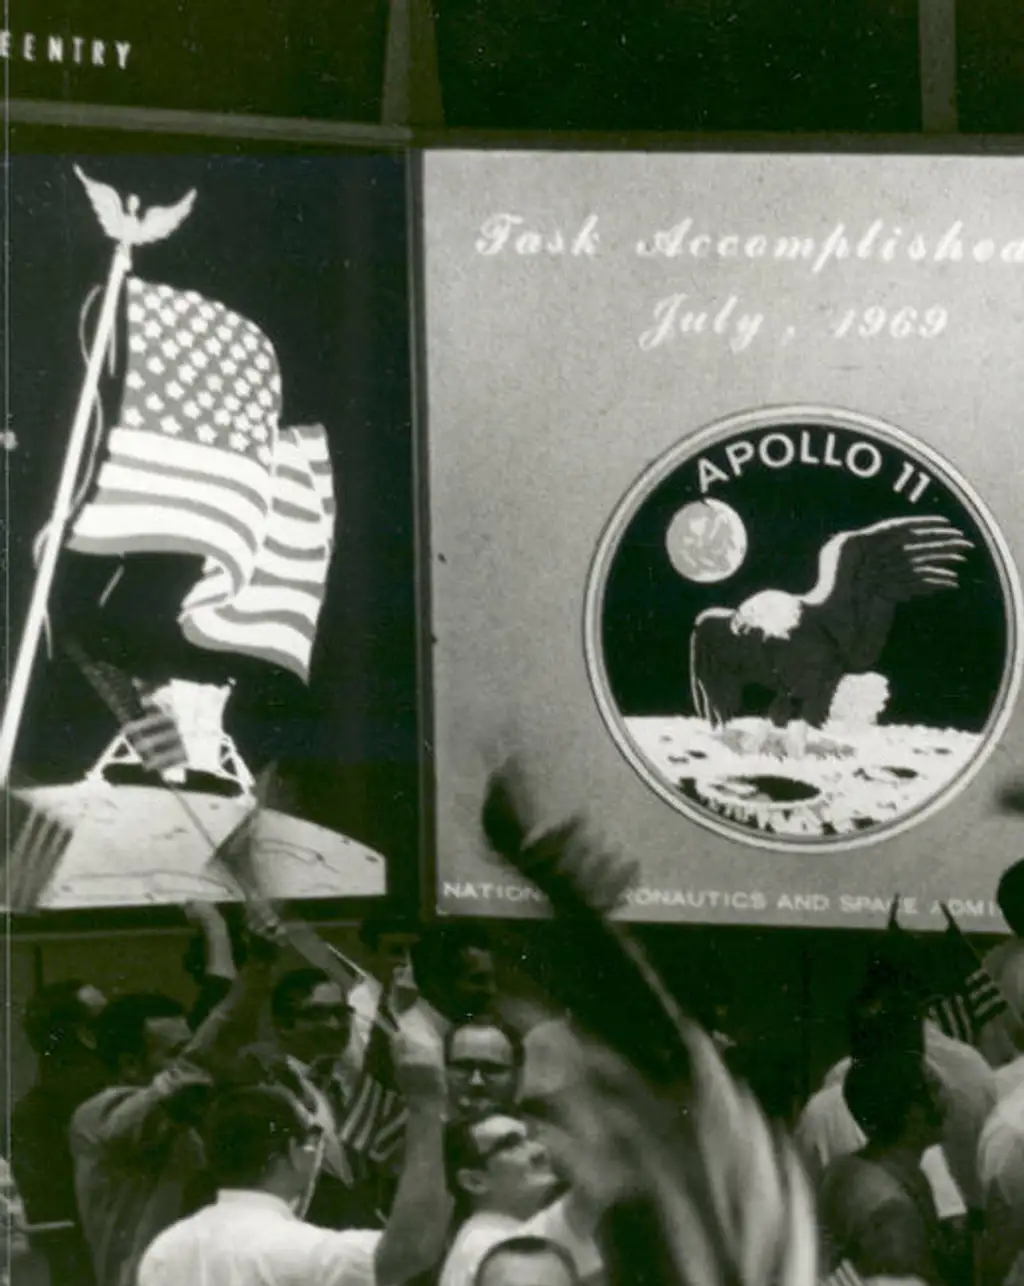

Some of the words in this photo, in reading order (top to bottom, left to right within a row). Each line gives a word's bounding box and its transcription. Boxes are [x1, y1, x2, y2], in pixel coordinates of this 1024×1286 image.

[475, 212, 603, 257] Task
[833, 304, 949, 339] 1969
[697, 431, 883, 494] APOLLO
[893, 460, 932, 504] 11
[776, 893, 831, 913] AND
